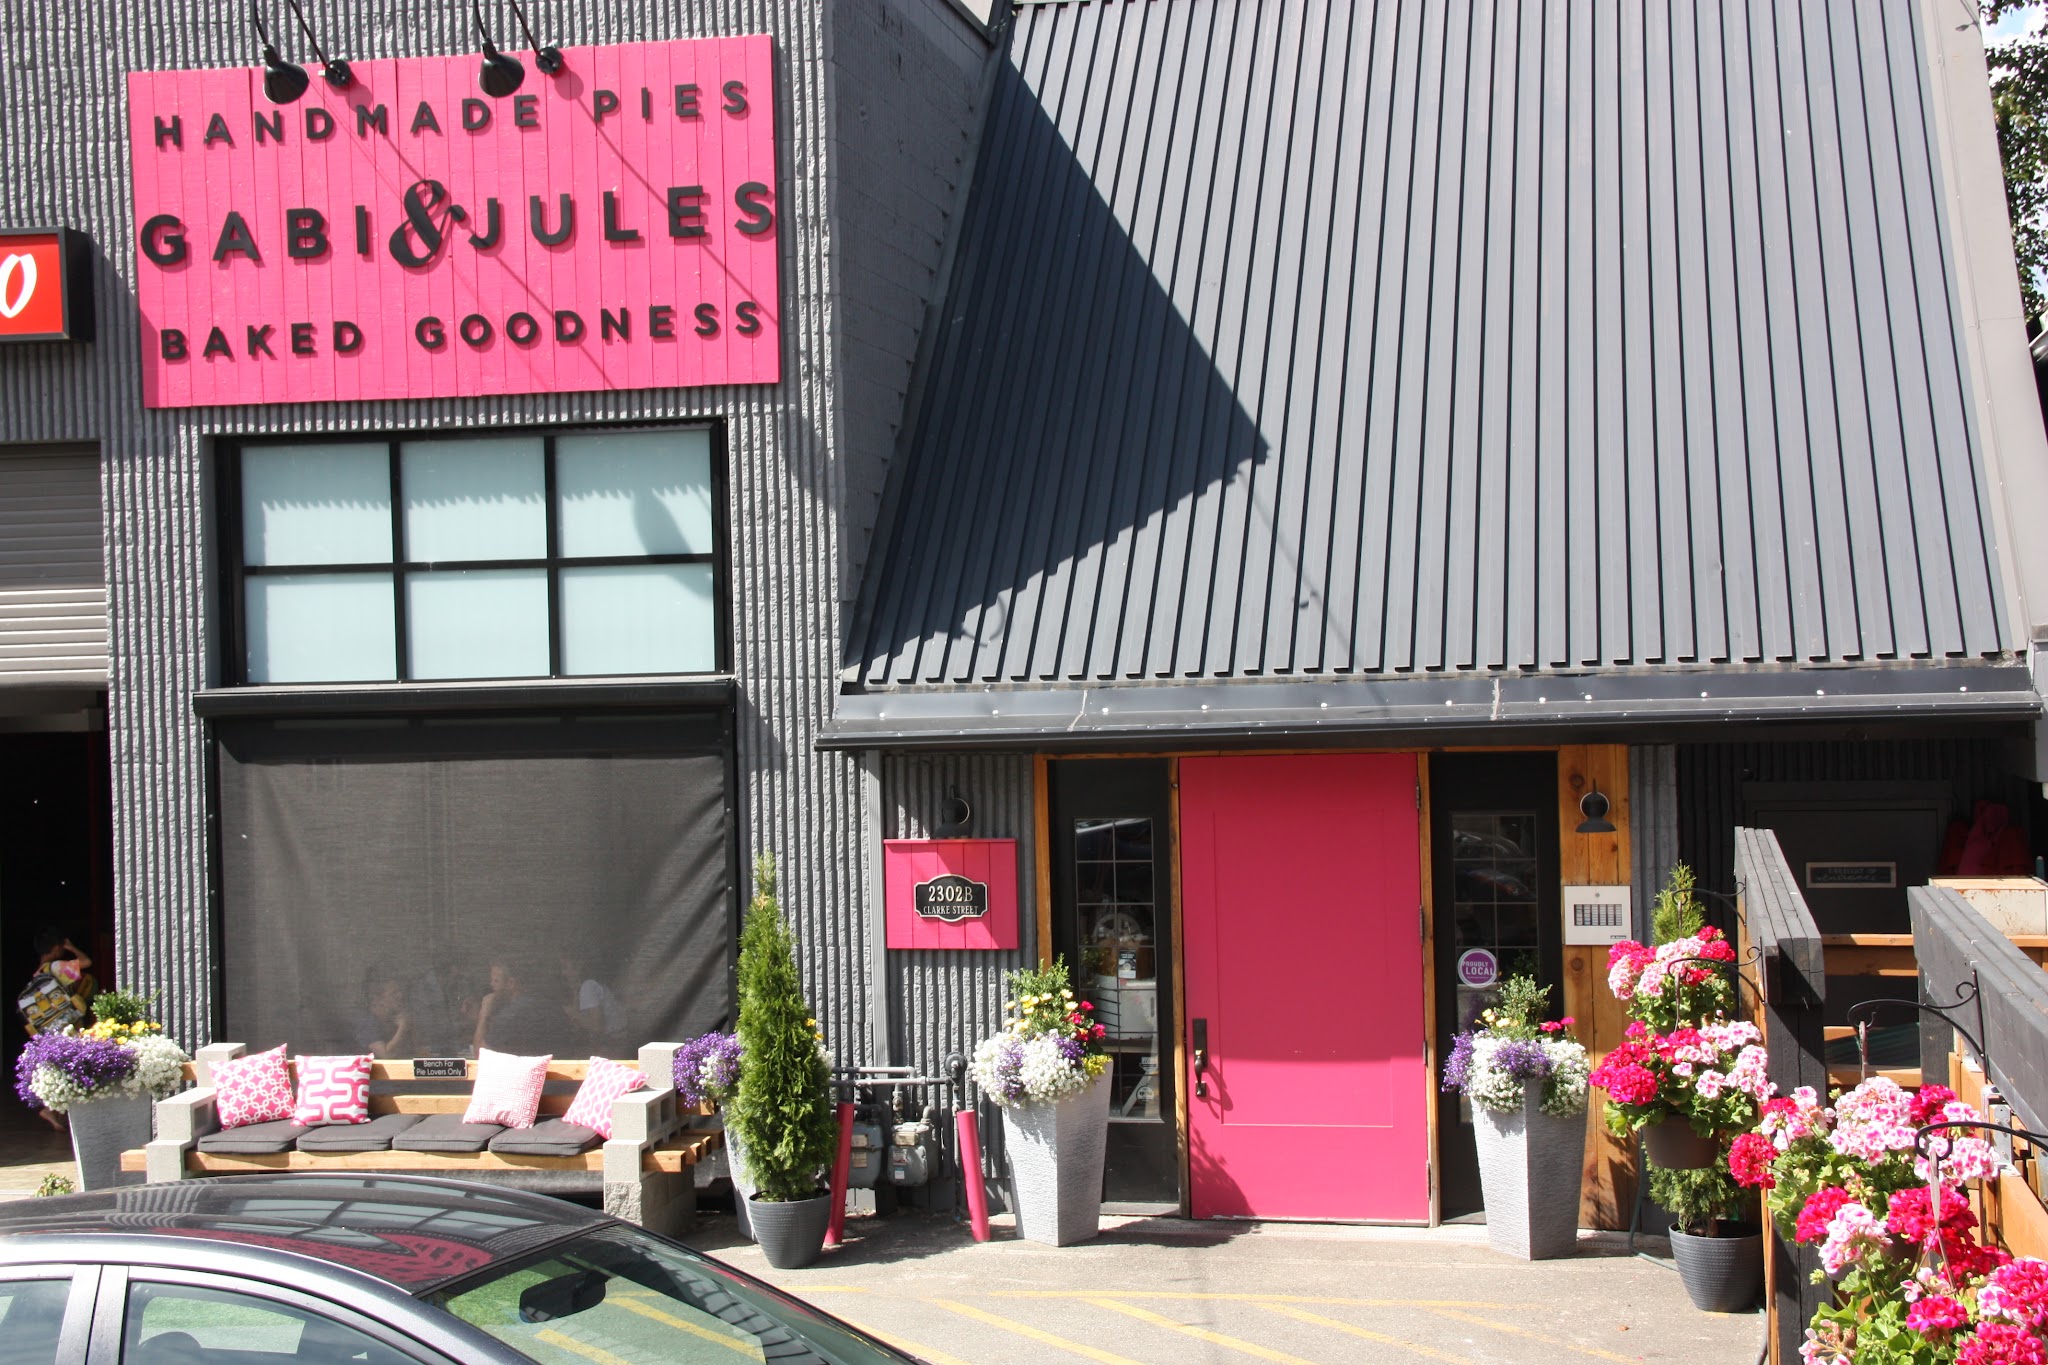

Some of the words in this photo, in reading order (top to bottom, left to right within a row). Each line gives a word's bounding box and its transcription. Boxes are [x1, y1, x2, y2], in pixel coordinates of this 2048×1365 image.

[155, 94, 539, 148] HANDMADE
[593, 80, 749, 124] PIES
[141, 205, 369, 265] GABI
[389, 179, 465, 267] &
[468, 181, 773, 249] JULES
[161, 321, 364, 359] BAKED
[415, 301, 761, 350] GOODNESS
[928, 885, 973, 902] 2302B
[923, 905, 950, 915] CLARKE
[952, 905, 979, 915] STREET
[1462, 960, 1489, 968] PROUDLY
[1465, 966, 1494, 976] LOCAL
[416, 1068, 426, 1076] Pie
[427, 1068, 447, 1076] Lovers
[447, 1068, 462, 1076] Only
